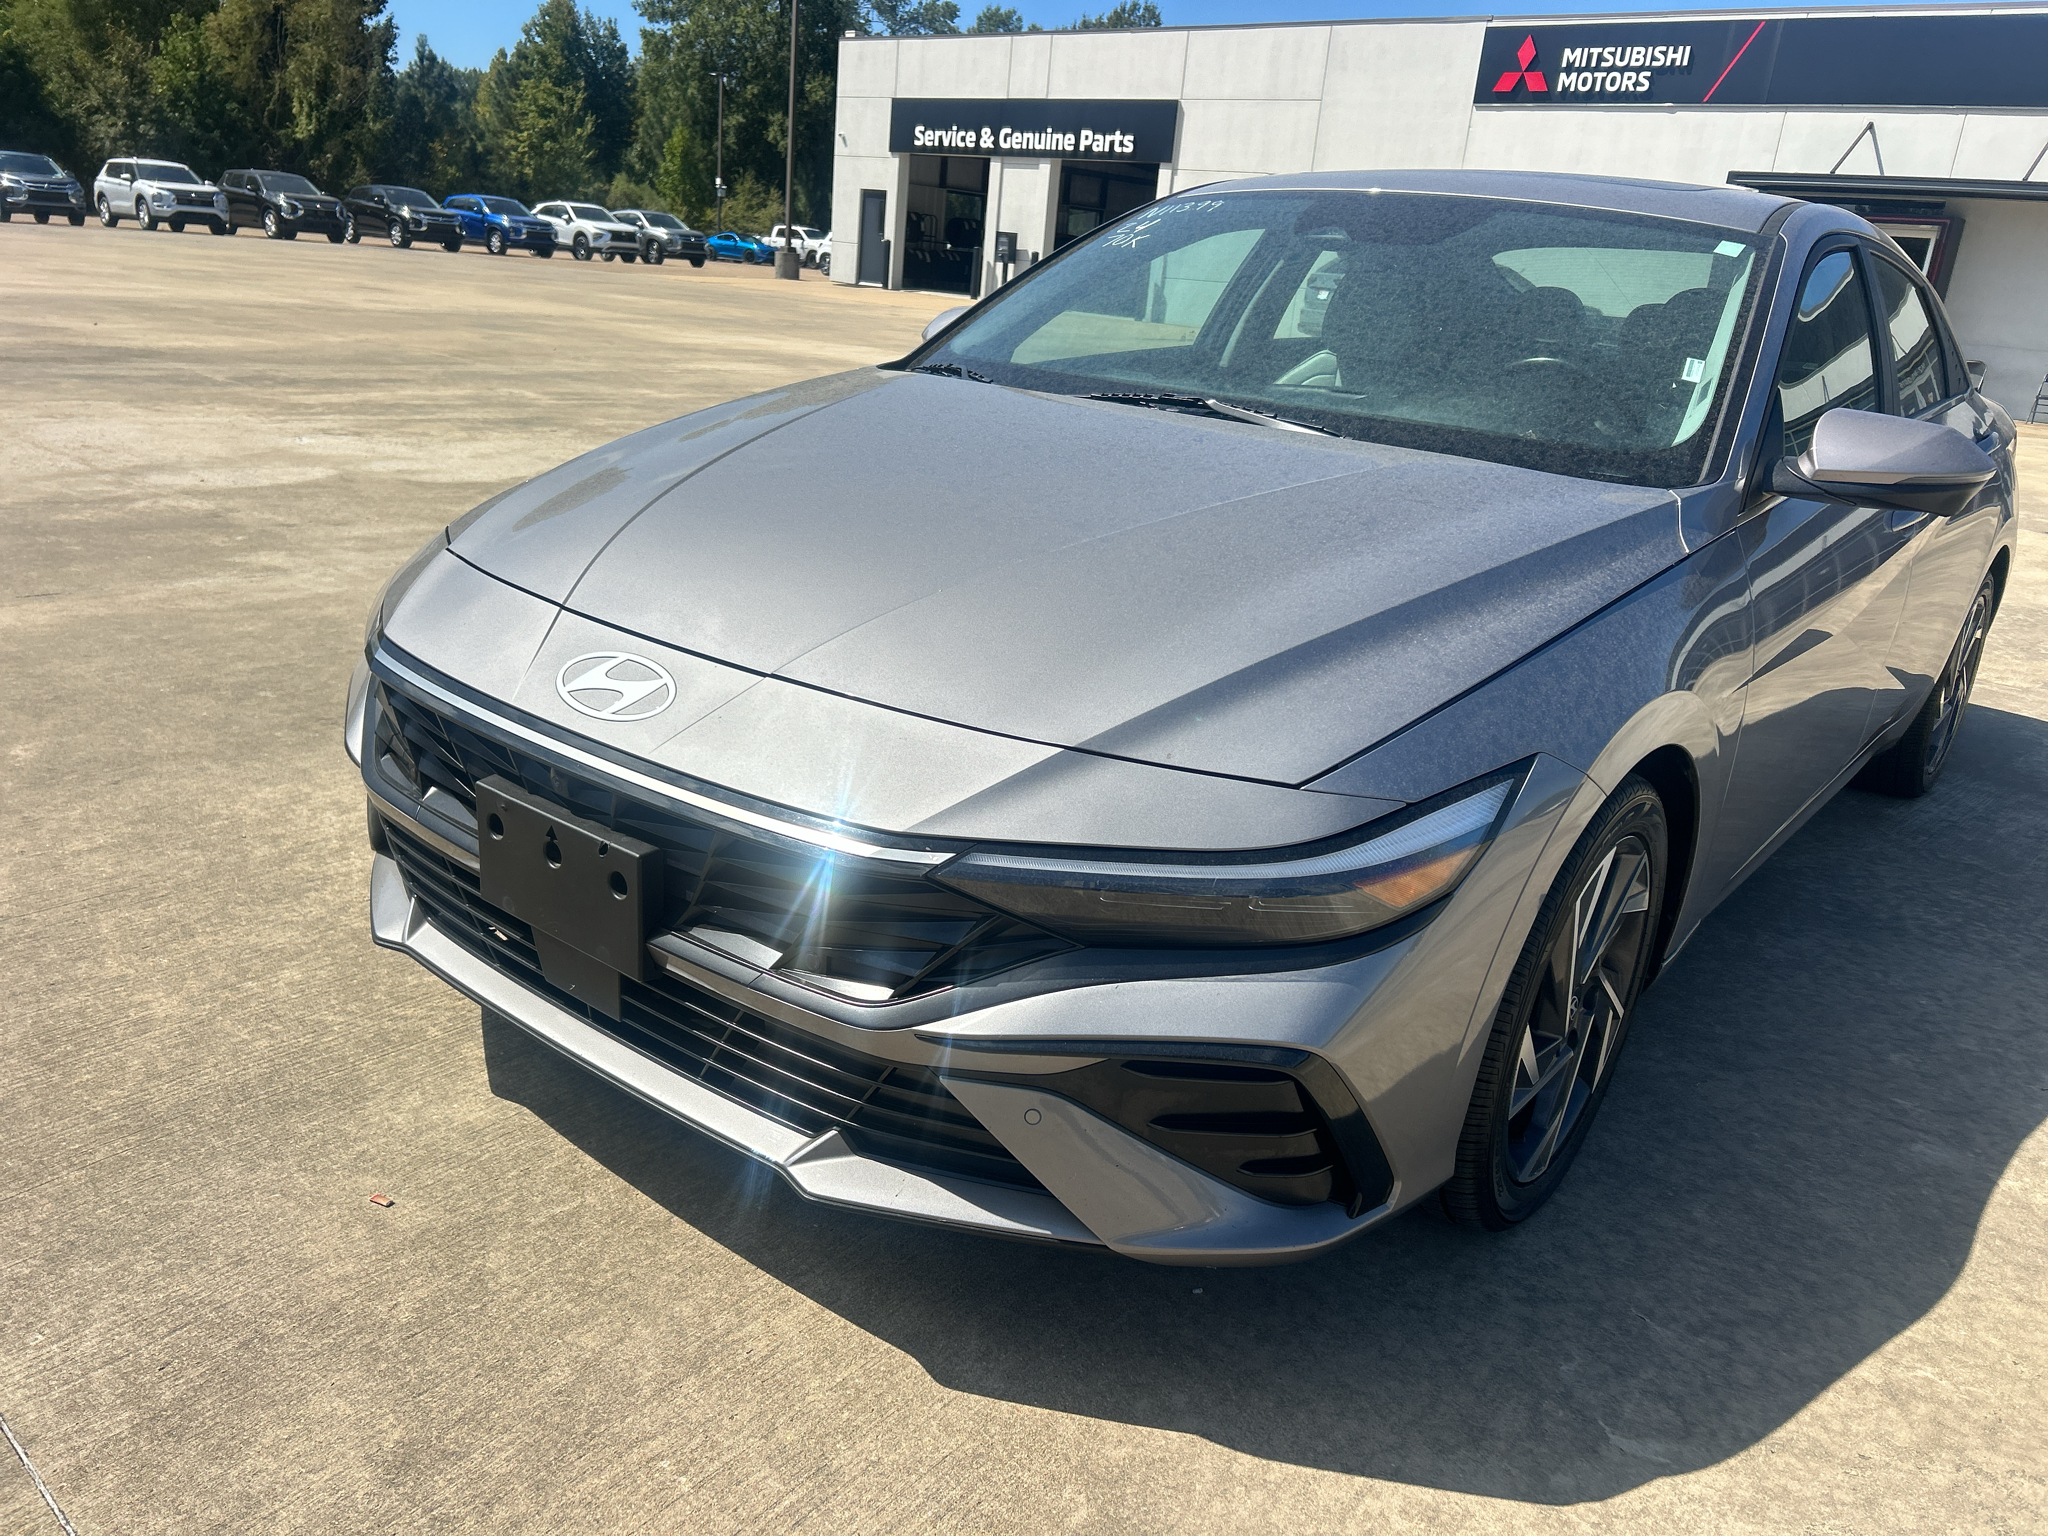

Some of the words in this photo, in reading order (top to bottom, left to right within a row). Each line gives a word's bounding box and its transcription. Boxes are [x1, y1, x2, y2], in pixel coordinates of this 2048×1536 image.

[1561, 45, 1692, 68] MITSUBISHI
[1556, 71, 1652, 92] MOTORS
[913, 125, 976, 147] Service
[979, 127, 995, 149] &
[999, 127, 1076, 151] Genuine
[1079, 130, 1135, 153] Parts
